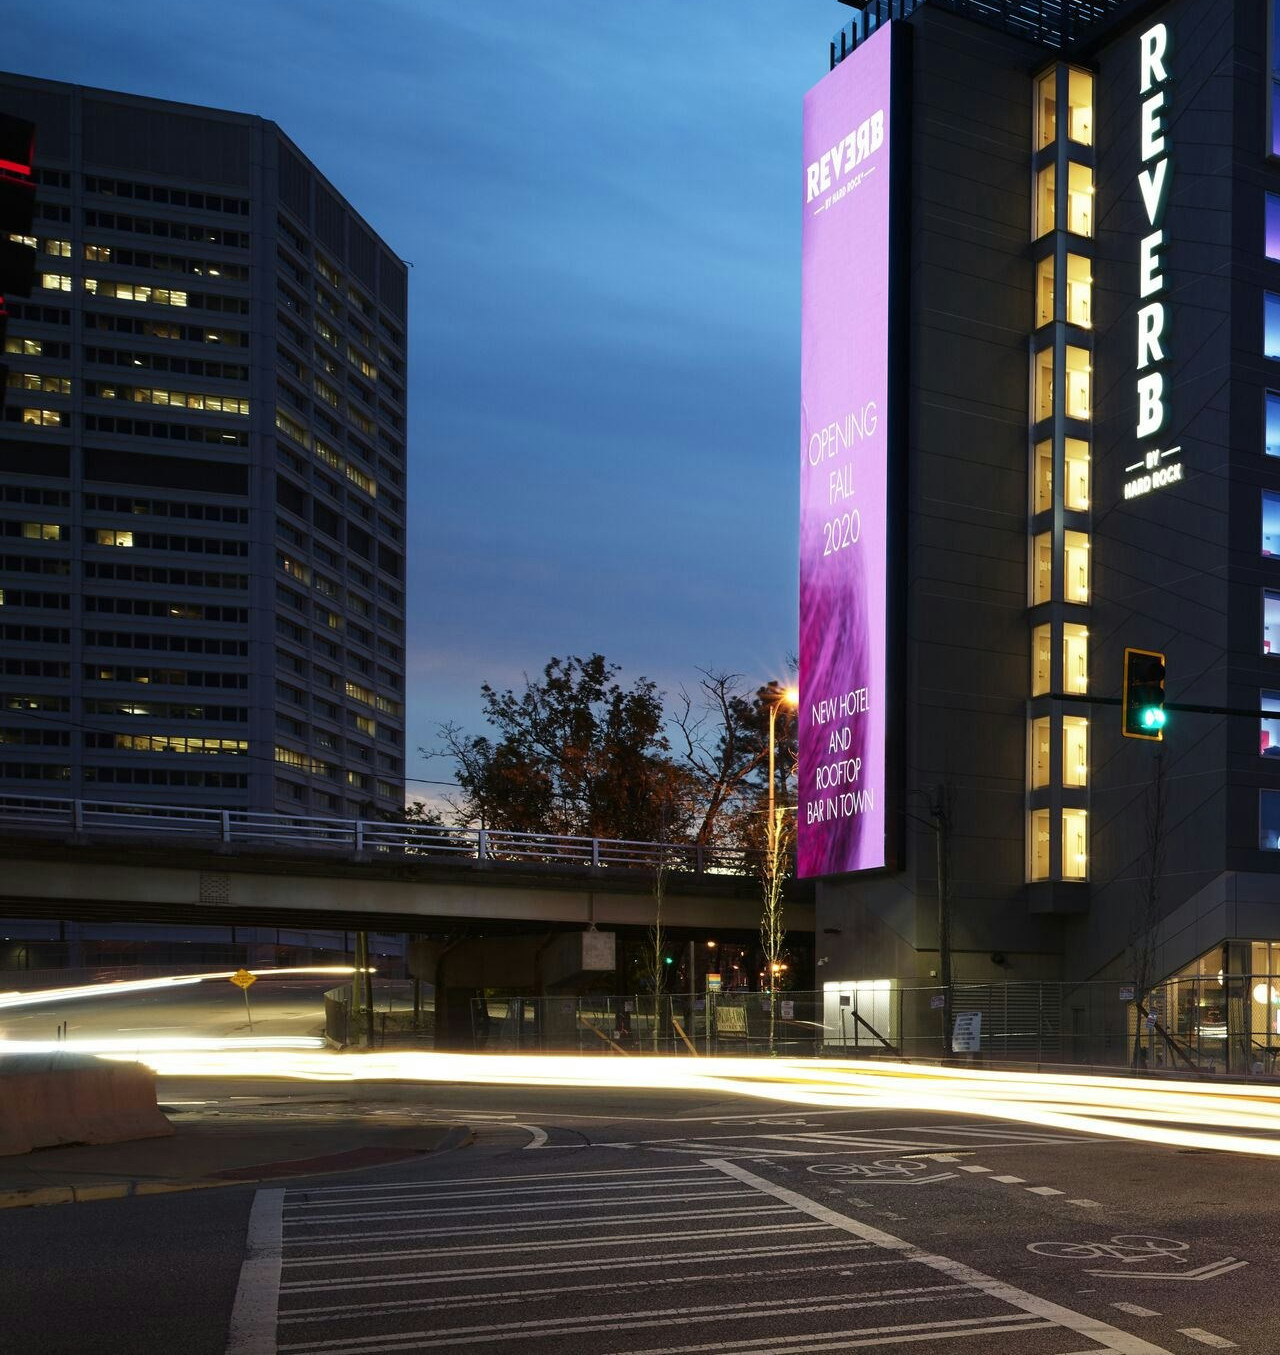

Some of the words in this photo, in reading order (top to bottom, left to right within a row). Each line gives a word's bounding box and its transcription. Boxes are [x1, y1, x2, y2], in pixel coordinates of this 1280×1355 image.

[806, 108, 884, 204] REVERB
[1136, 22, 1171, 440] REVERB
[808, 401, 878, 466] OPENING
[1146, 448, 1160, 469] BY
[829, 462, 855, 505] FALL
[1124, 475, 1152, 500] HARD
[1152, 462, 1182, 489] ROCK
[823, 508, 861, 556] 2020
[812, 697, 838, 727] NEW
[839, 687, 870, 719] HOTEL
[828, 727, 852, 754] AND
[816, 757, 862, 790] ROOFTOP
[807, 798, 824, 824] BAR
[827, 797, 838, 821] IN
[841, 788, 874, 817] TOWN
